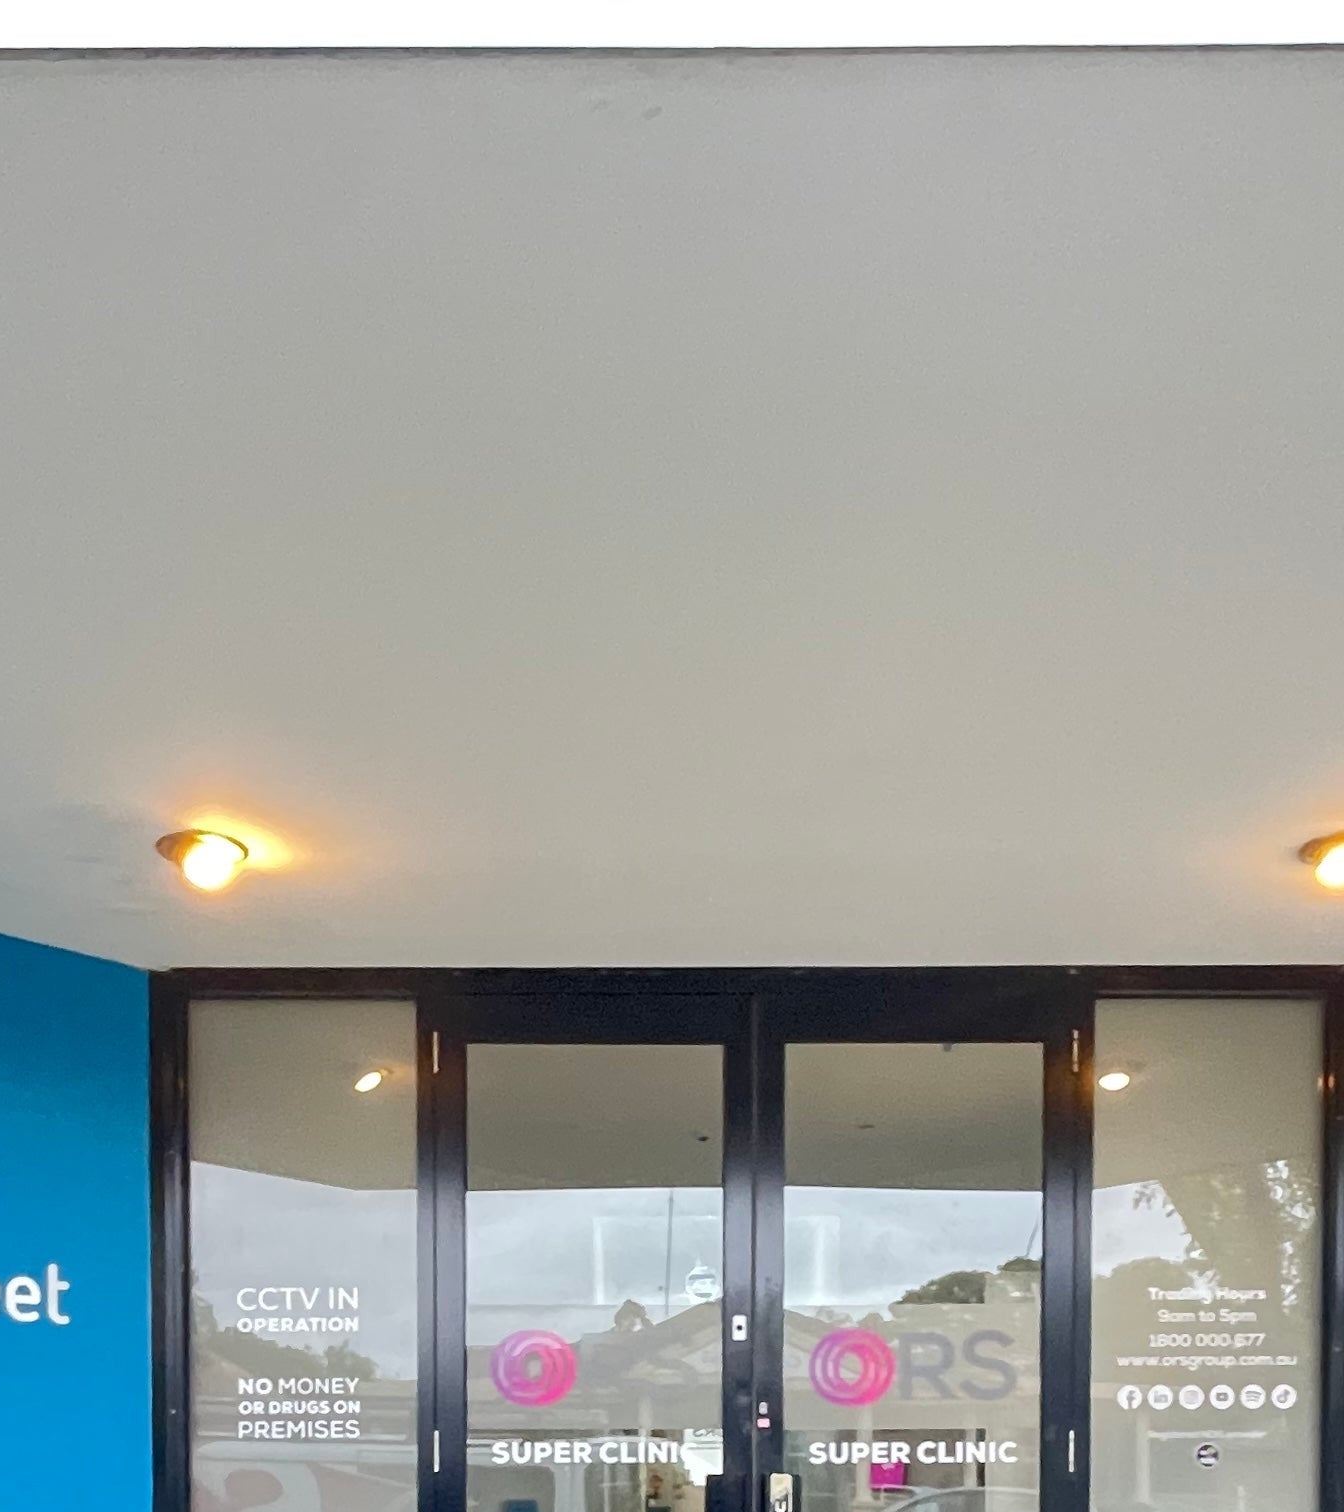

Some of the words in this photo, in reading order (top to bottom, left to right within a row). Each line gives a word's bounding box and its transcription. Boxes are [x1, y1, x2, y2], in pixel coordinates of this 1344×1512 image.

[236, 1287, 321, 1311] CCTV
[328, 1286, 359, 1310] IN
[236, 1317, 360, 1333] OPERATION
[1198, 1311, 1216, 1322] to
[808, 1328, 1019, 1408] ORS
[1116, 1355, 1298, 1371] www.orsgroup.com.au
[237, 1378, 273, 1395] NO
[277, 1377, 360, 1395] MONEY
[238, 1401, 265, 1416] OR
[268, 1400, 331, 1416] DRUGS
[333, 1399, 361, 1415] ON
[237, 1419, 361, 1440] PREMISES
[491, 1441, 593, 1465] SUPER
[808, 1441, 911, 1465] SUPER
[917, 1441, 1019, 1465] CLINIC
